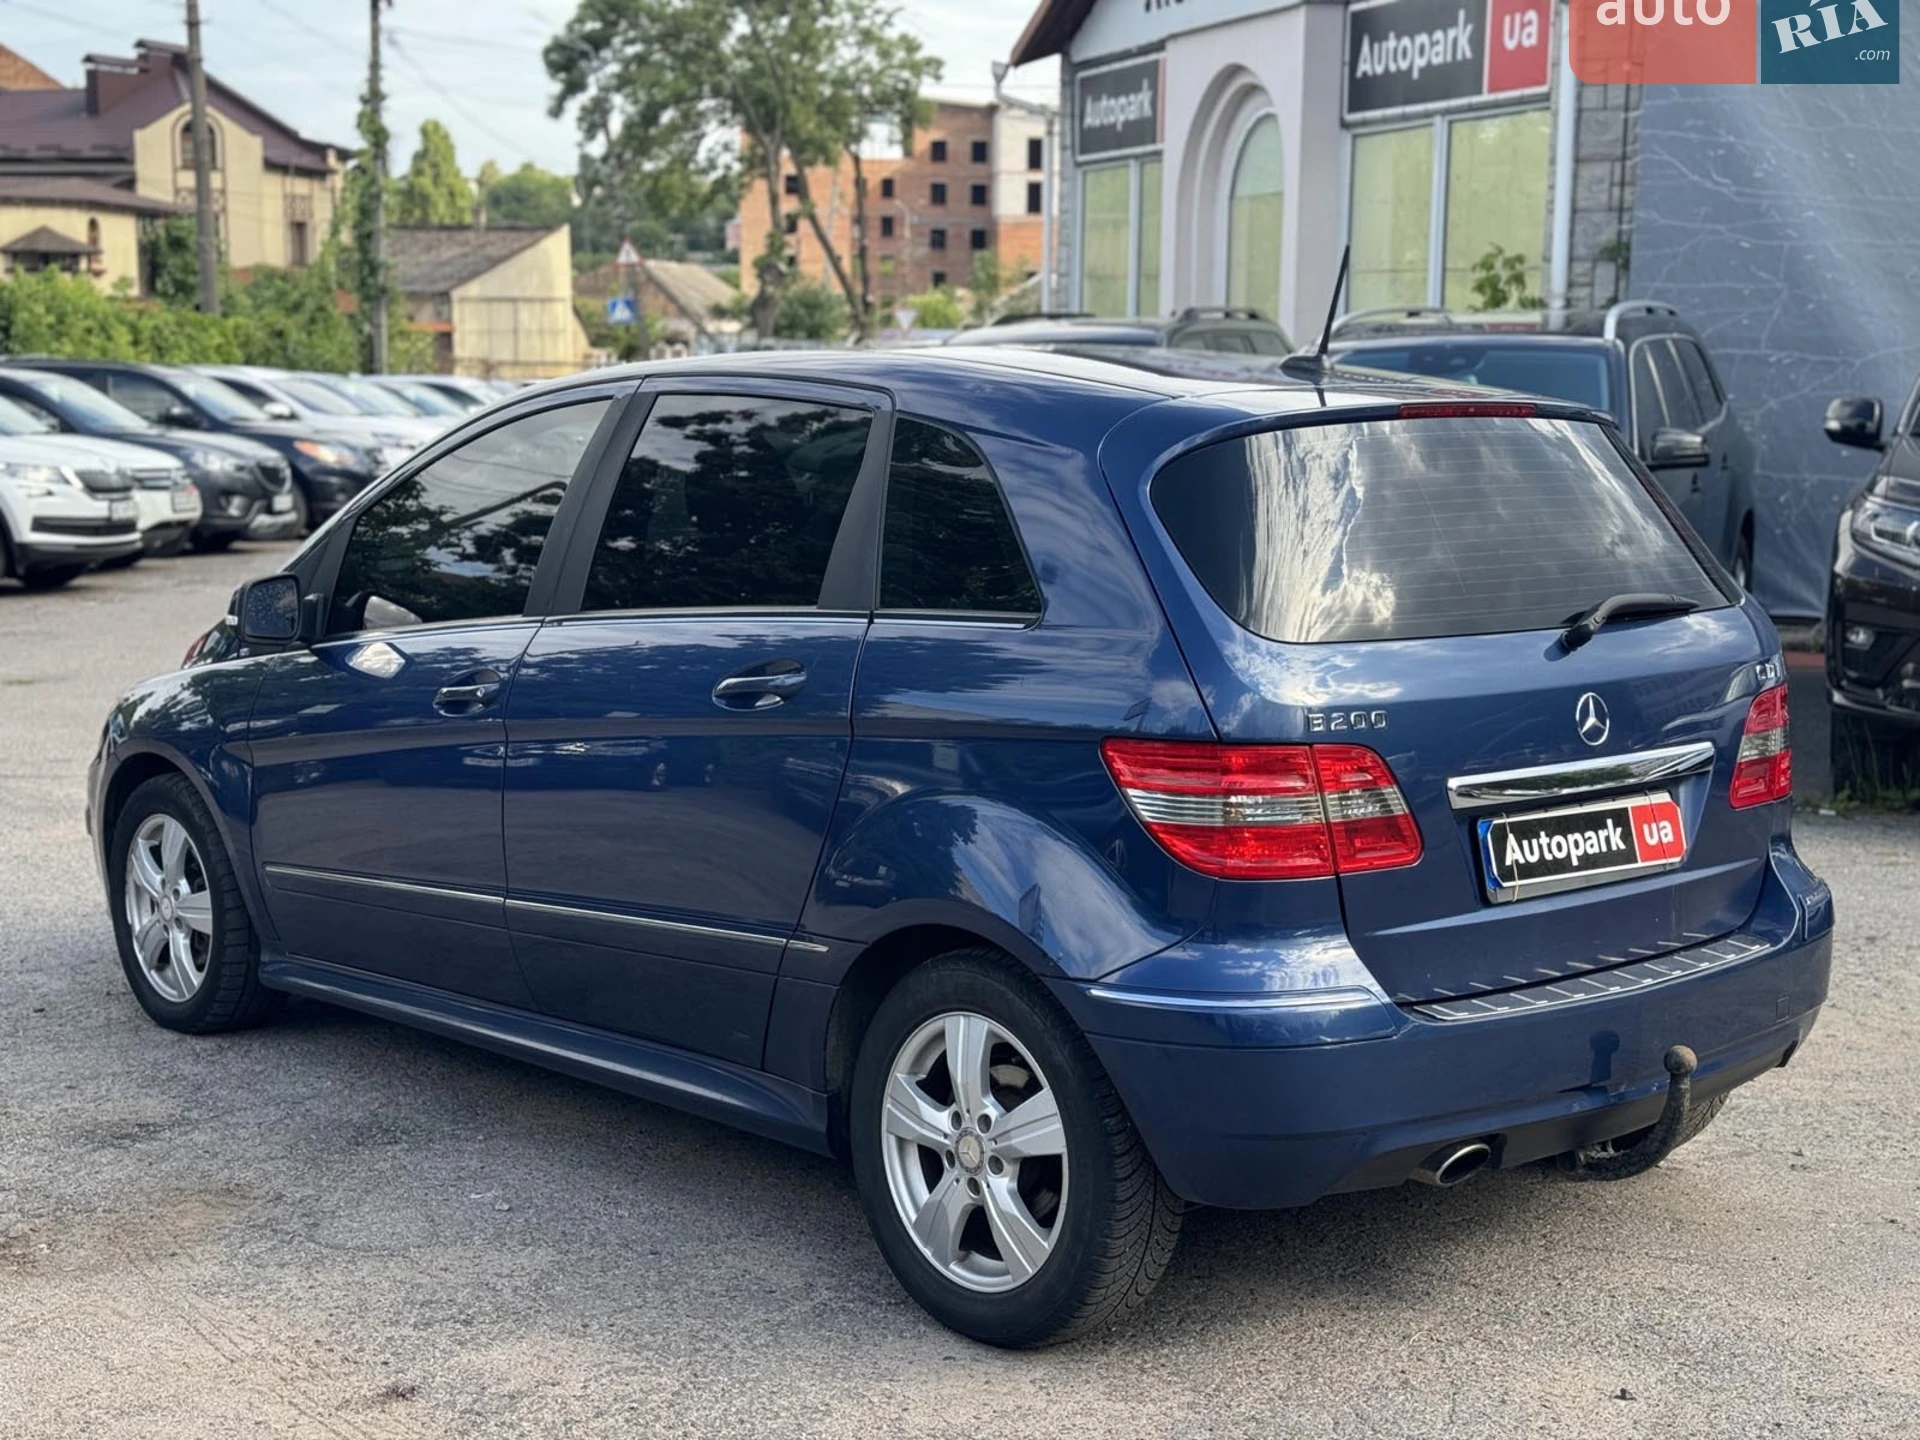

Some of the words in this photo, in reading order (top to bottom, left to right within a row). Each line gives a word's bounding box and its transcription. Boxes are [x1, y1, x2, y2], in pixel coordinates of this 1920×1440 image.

[1355, 8, 1474, 80] Autopark
[1503, 9, 1539, 50] ua
[1083, 78, 1153, 131] Autopark
[1307, 710, 1388, 732] B200
[1504, 818, 1626, 867] Autopark
[1642, 819, 1674, 846] ua
